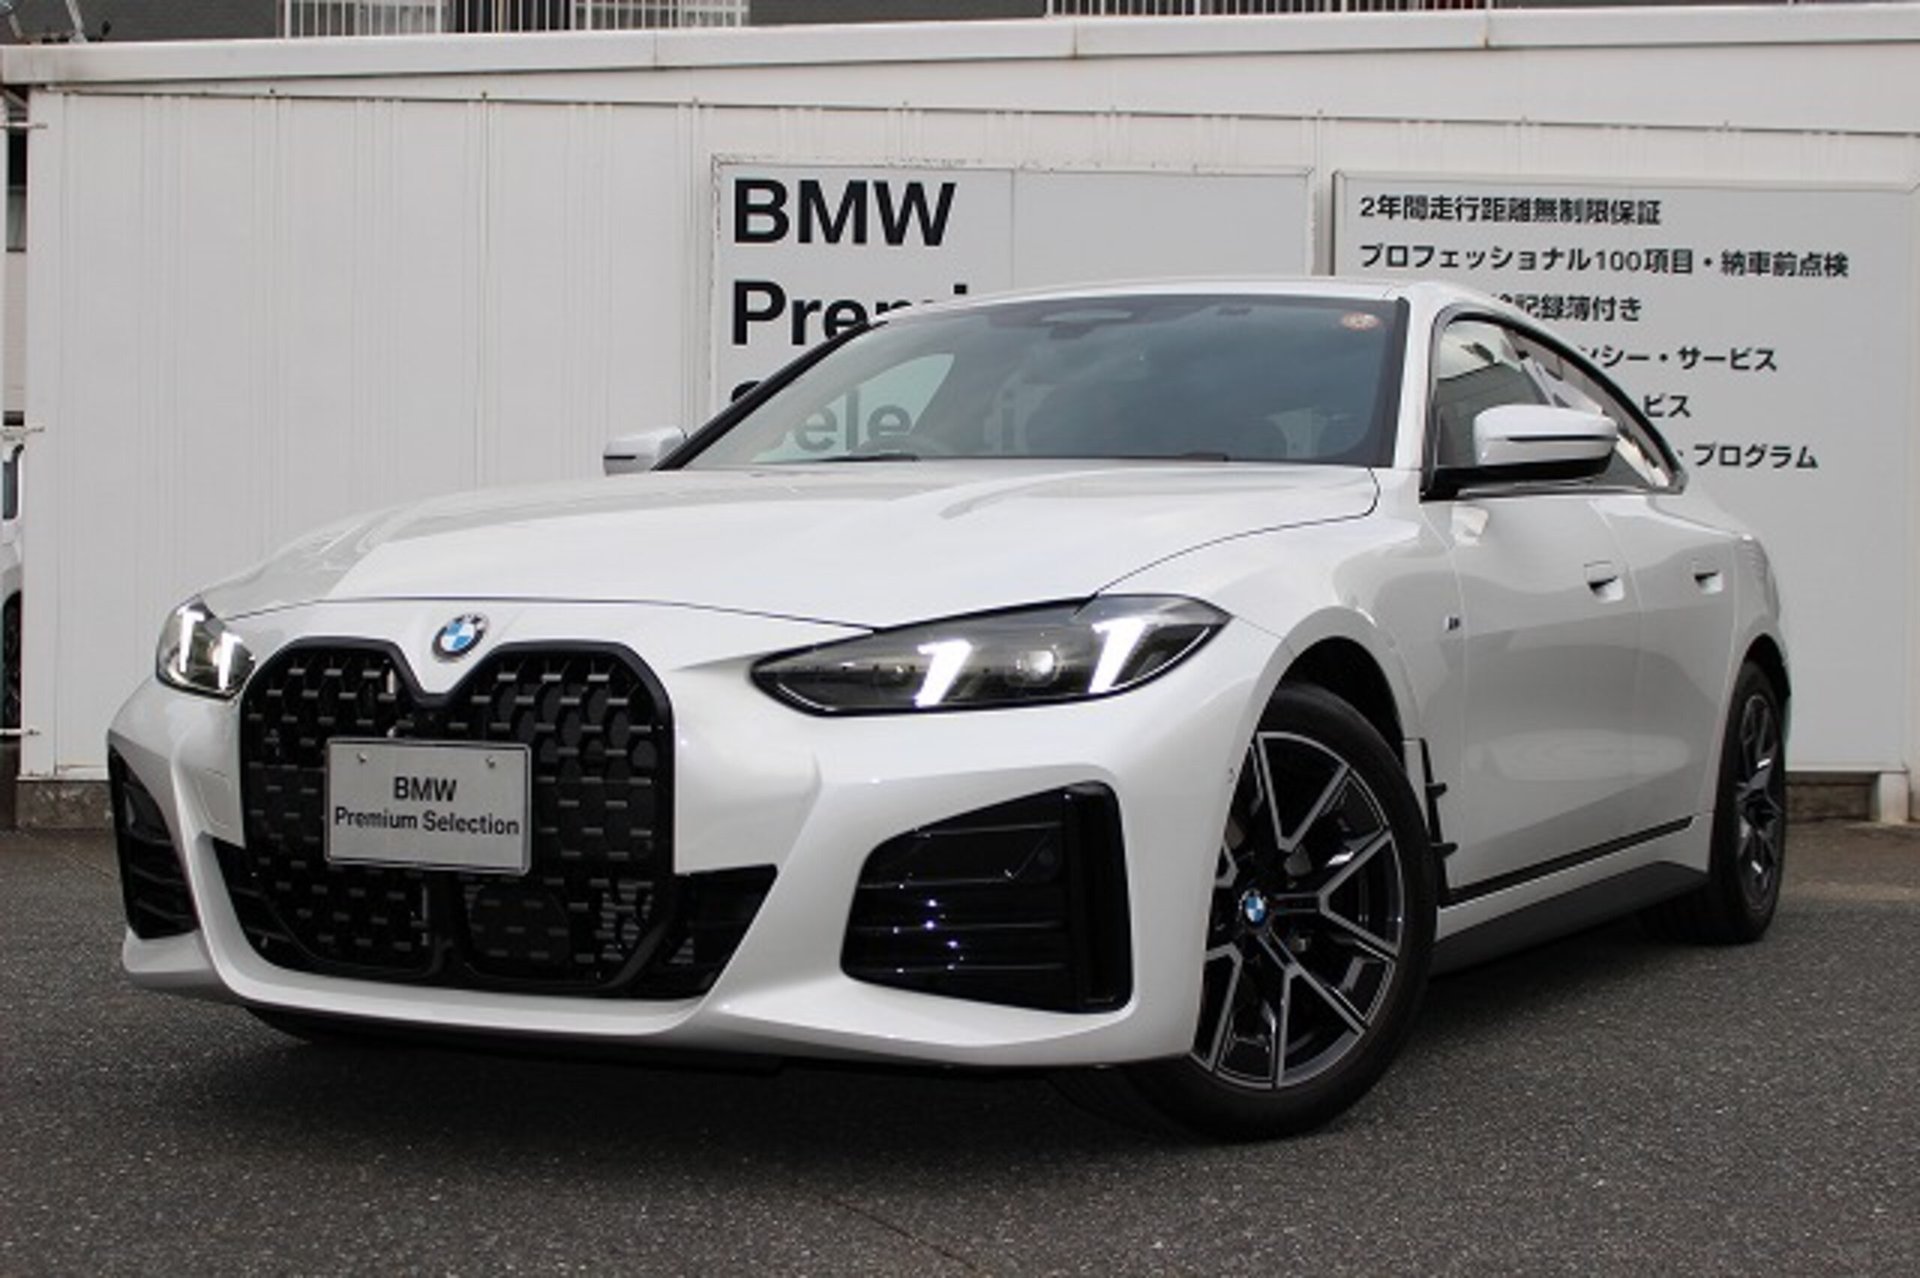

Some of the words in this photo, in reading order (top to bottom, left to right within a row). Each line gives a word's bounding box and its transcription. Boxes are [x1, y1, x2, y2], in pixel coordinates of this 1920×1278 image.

[734, 178, 957, 247] BMW
[1359, 194, 1662, 225] 2年間走行距離無制限保証
[393, 776, 457, 802] BMW
[334, 806, 418, 830] Premium
[422, 809, 520, 835] Selection
